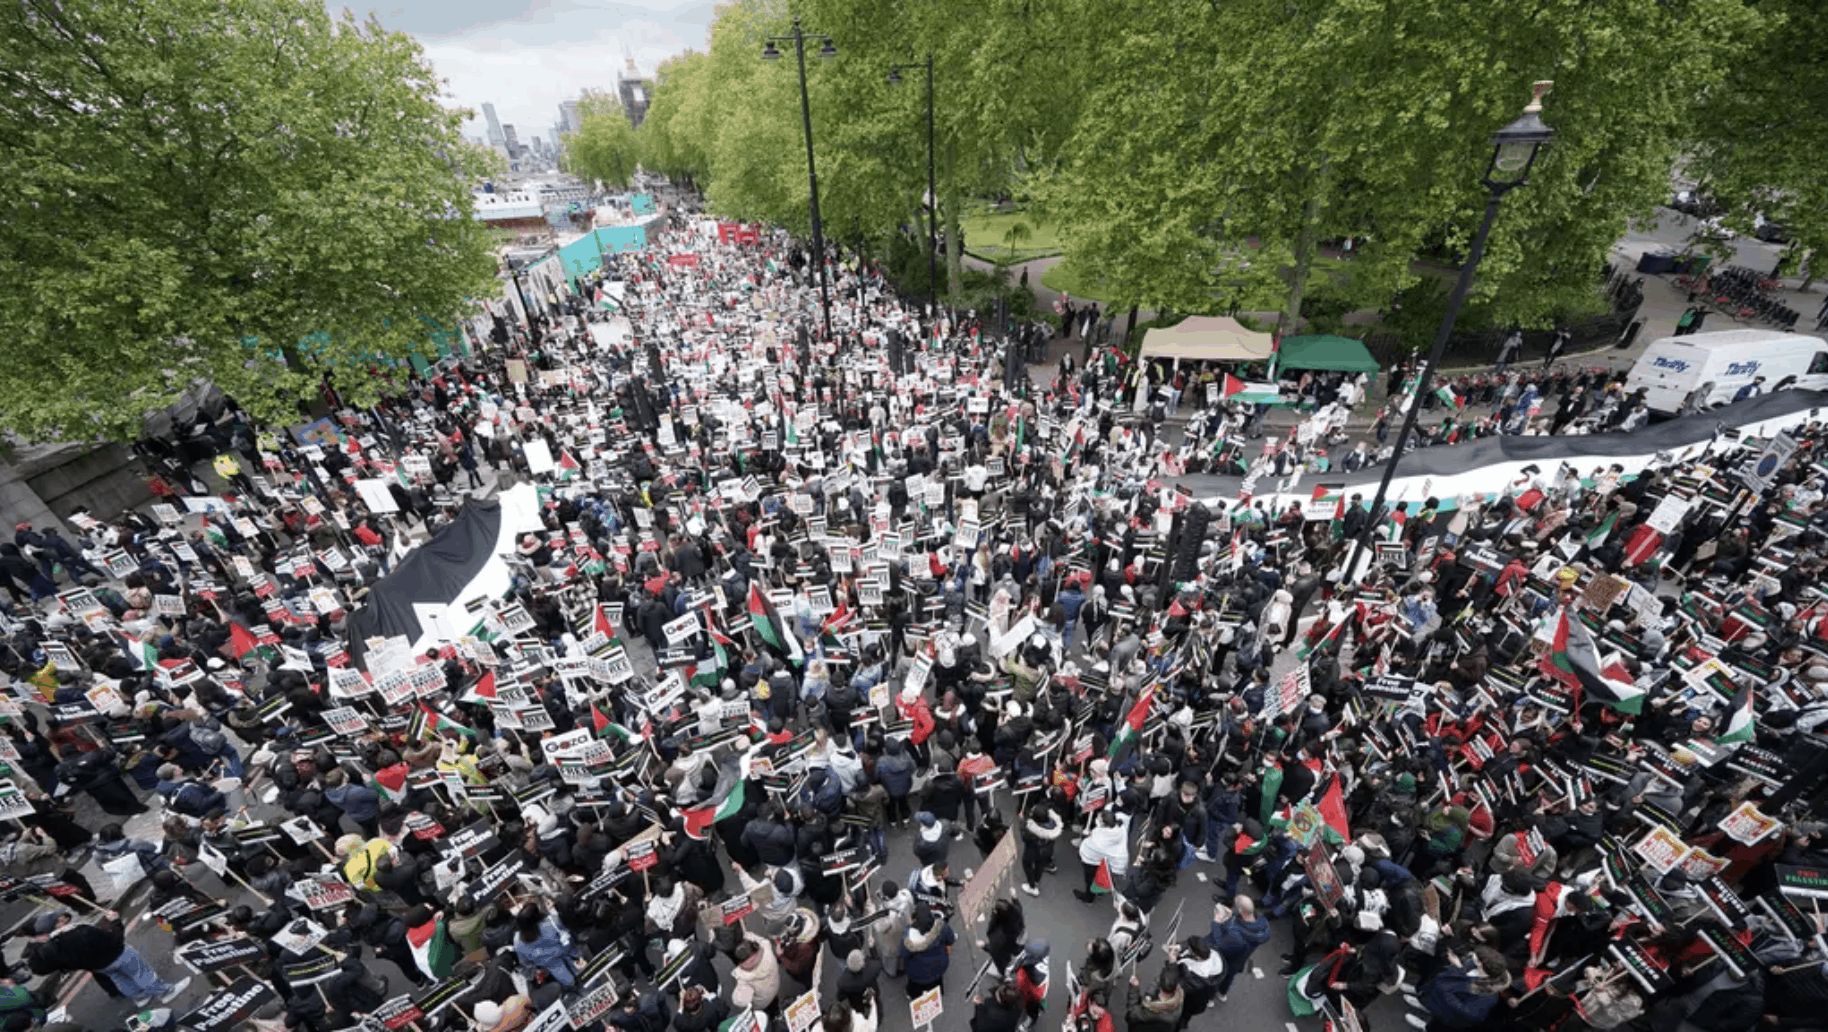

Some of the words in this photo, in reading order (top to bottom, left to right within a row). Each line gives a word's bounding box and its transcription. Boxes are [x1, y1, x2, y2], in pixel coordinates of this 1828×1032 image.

[1653, 357, 1691, 373] Thrifty
[1724, 360, 1761, 377] Thrifty
[449, 829, 475, 846] Free
[473, 860, 523, 901] Palestine
[481, 863, 508, 884] Free
[194, 984, 264, 1031] Palestine
[198, 993, 236, 1017] Free
